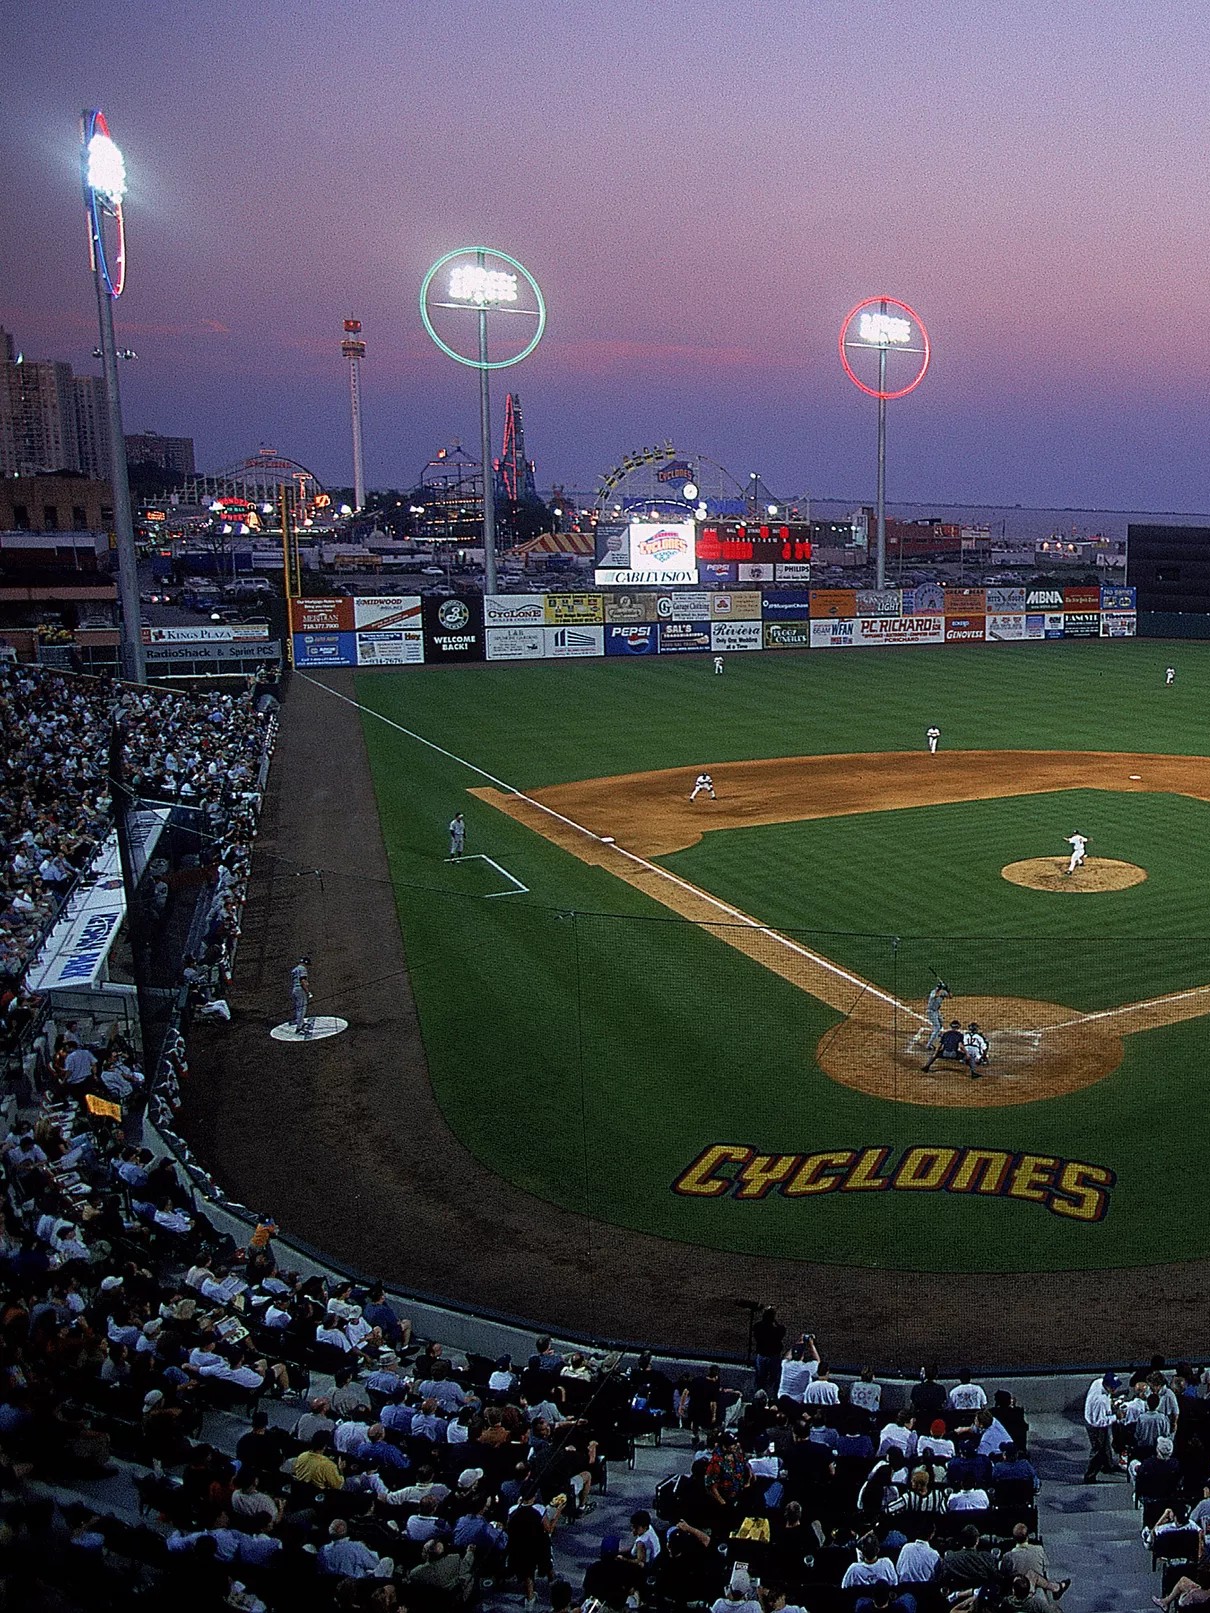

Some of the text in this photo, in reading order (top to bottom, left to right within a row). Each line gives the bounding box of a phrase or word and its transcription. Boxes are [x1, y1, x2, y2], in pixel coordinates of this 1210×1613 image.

[658, 468, 693, 482] CYCLONES
[639, 538, 688, 556] CYCLONES
[615, 571, 692, 584] CABLEVISION
[1026, 591, 1064, 605] MBNA
[878, 603, 900, 611] LIGHT
[488, 609, 541, 618] CYCLONE
[666, 625, 692, 633] SAL'S
[713, 624, 760, 635] Riviera
[831, 623, 854, 635] WFAN
[861, 618, 931, 632] P.C. RICHARD
[168, 630, 199, 640] KINGS
[200, 630, 232, 639] PLAZA
[611, 627, 651, 637] PEPSI
[946, 630, 984, 639] GENOVESE
[434, 636, 476, 644] WELCOME
[146, 648, 211, 658] RadioShack
[230, 647, 255, 657] Sprint
[256, 646, 274, 655] PCS
[58, 952, 101, 981] PARK
[670, 1142, 1117, 1223] CYCLONES
